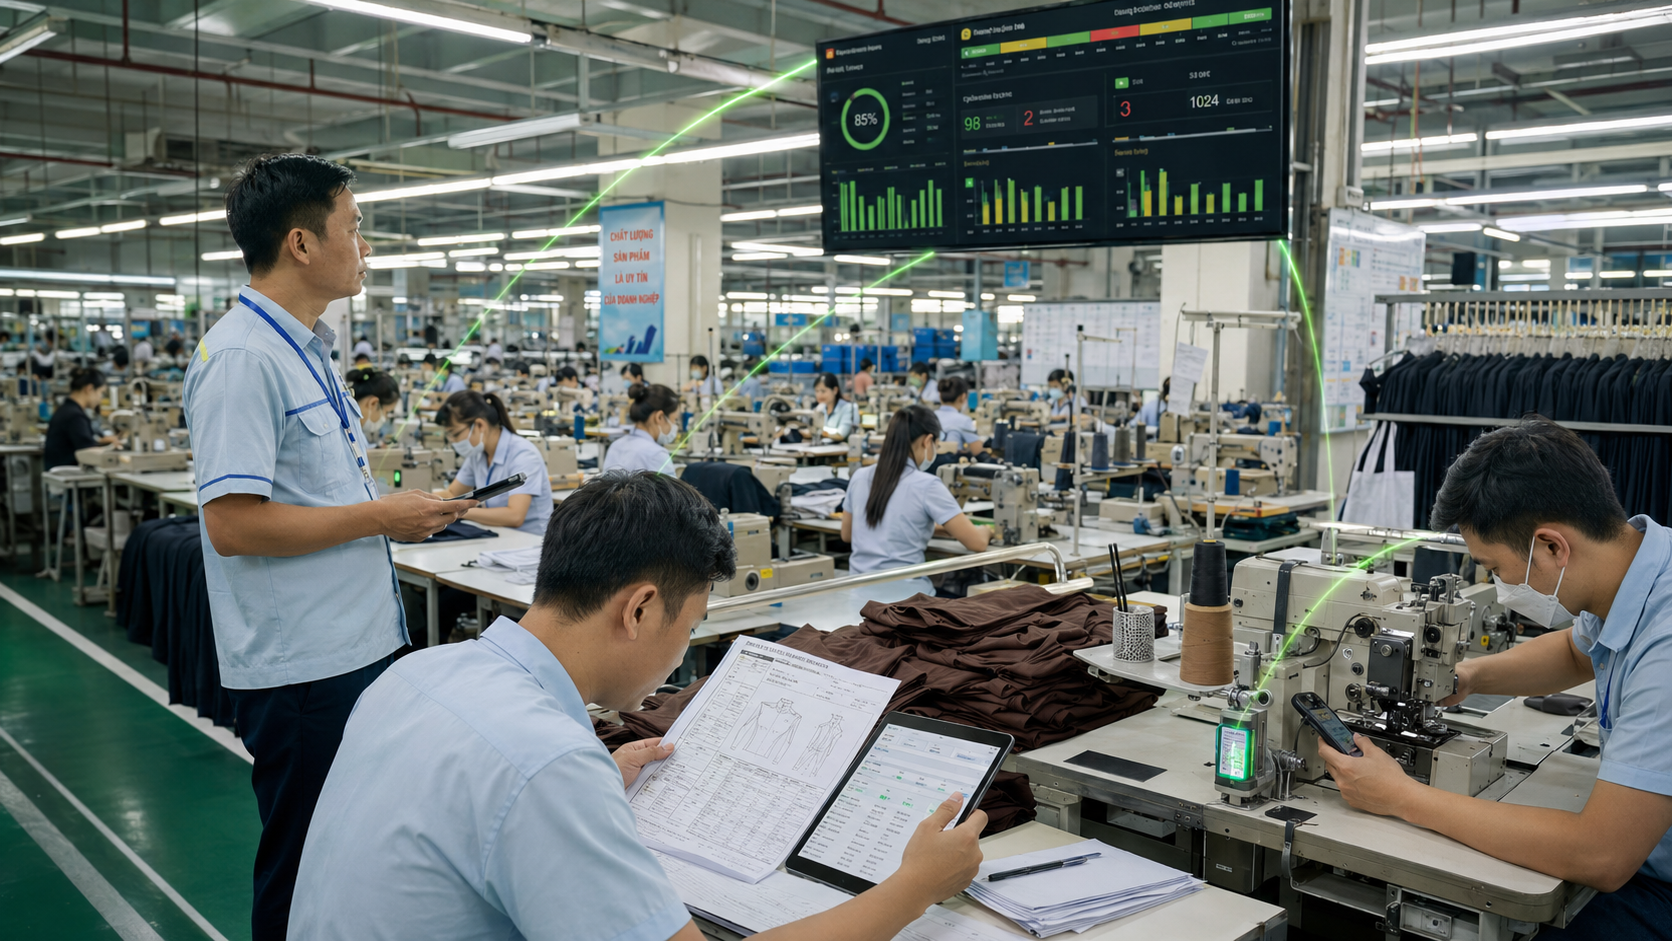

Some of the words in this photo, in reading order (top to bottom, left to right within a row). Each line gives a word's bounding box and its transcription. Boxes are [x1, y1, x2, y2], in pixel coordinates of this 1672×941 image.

[1119, 100, 1131, 118] 3
[1189, 93, 1220, 109] 1024
[854, 112, 878, 127] 85%
[964, 115, 981, 131] 98
[1023, 109, 1034, 126] 2
[625, 273, 635, 284] UY
